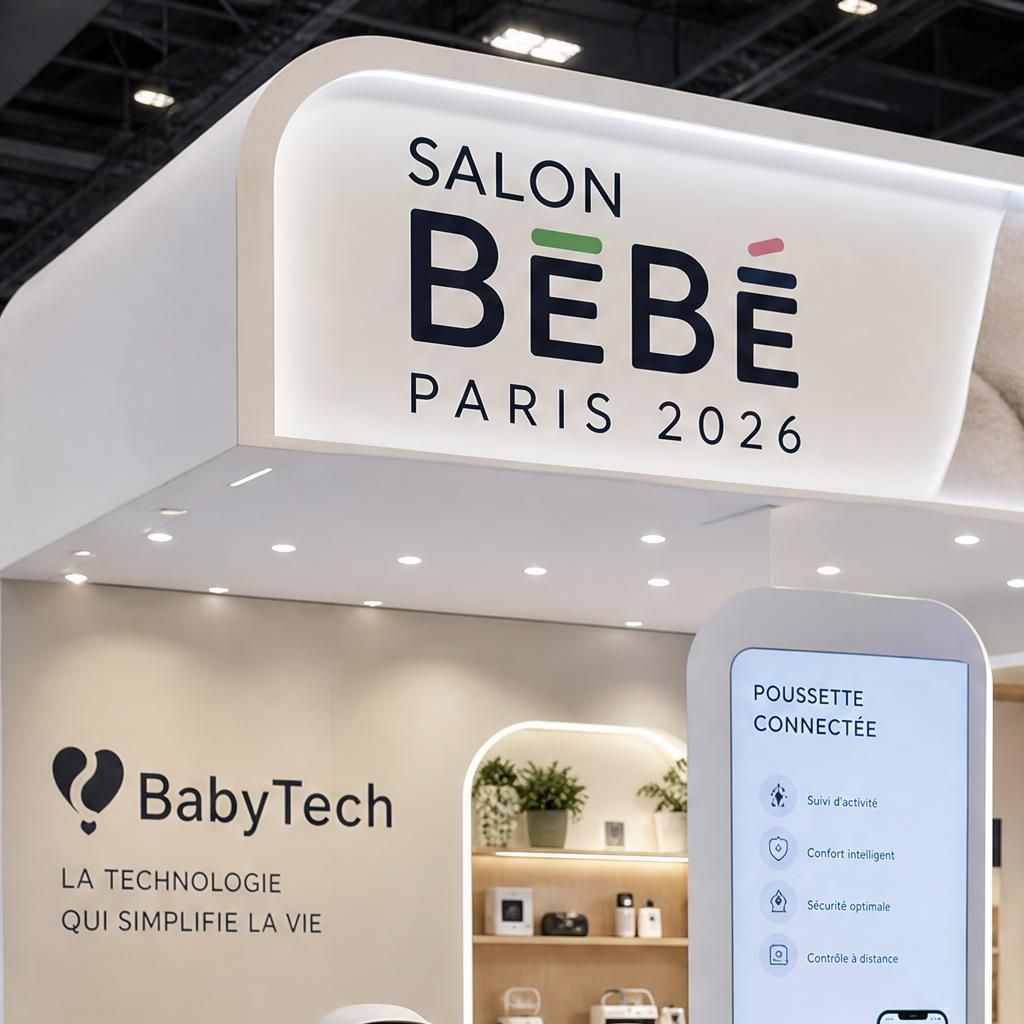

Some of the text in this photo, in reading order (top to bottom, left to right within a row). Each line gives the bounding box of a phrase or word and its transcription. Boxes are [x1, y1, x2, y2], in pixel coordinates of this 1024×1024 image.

[407, 136, 621, 218] SALON
[410, 372, 802, 454] PARIS 2026
[754, 684, 864, 707] POUSSETTE
[753, 715, 877, 738] CONNECTÉE
[139, 772, 393, 837] BabyTech
[807, 795, 831, 806] Suivi
[807, 847, 895, 862] Confort intelligent
[62, 868, 281, 893] LA TECHNOLOGIE
[807, 899, 891, 913] Sécurité optimale
[61, 909, 322, 934] QUI SIMPLIFIE LA VIE
[807, 952, 899, 964] Contrôle à distance
